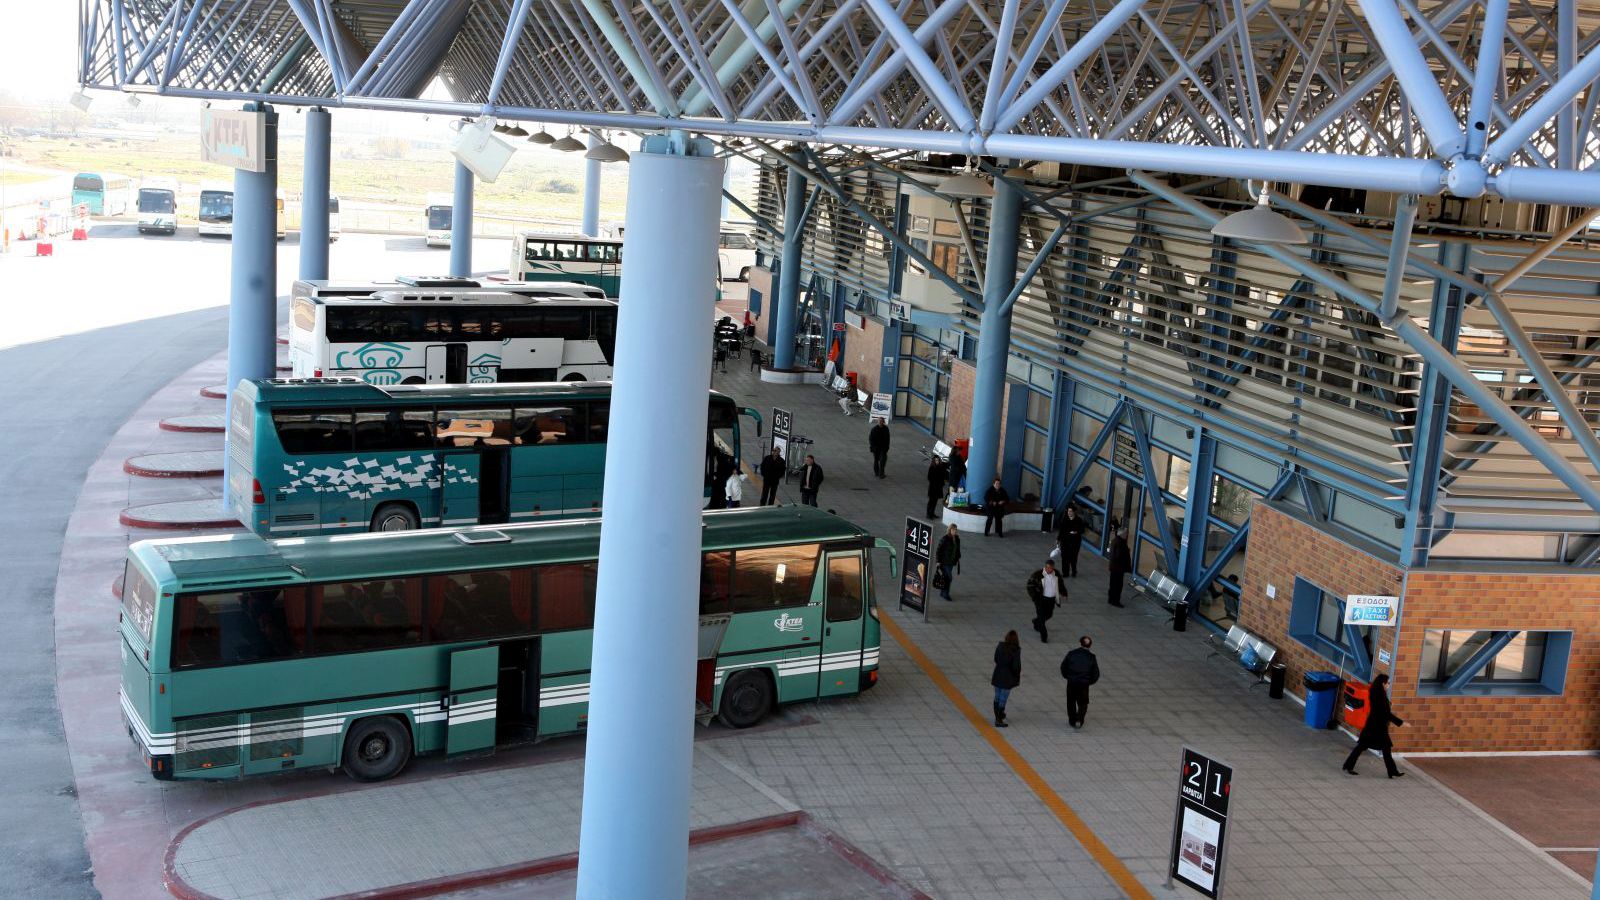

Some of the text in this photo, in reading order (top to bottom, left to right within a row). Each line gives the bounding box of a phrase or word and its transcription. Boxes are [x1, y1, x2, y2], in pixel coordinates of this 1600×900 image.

[775, 413, 789, 428] 6 5
[910, 527, 929, 546] 4 3
[1356, 597, 1388, 605] ΕΞΟΔΟΣ
[1188, 761, 1222, 798] 2 1
[1182, 785, 1203, 801] ΚΑΡΔΙΤΣΑ
